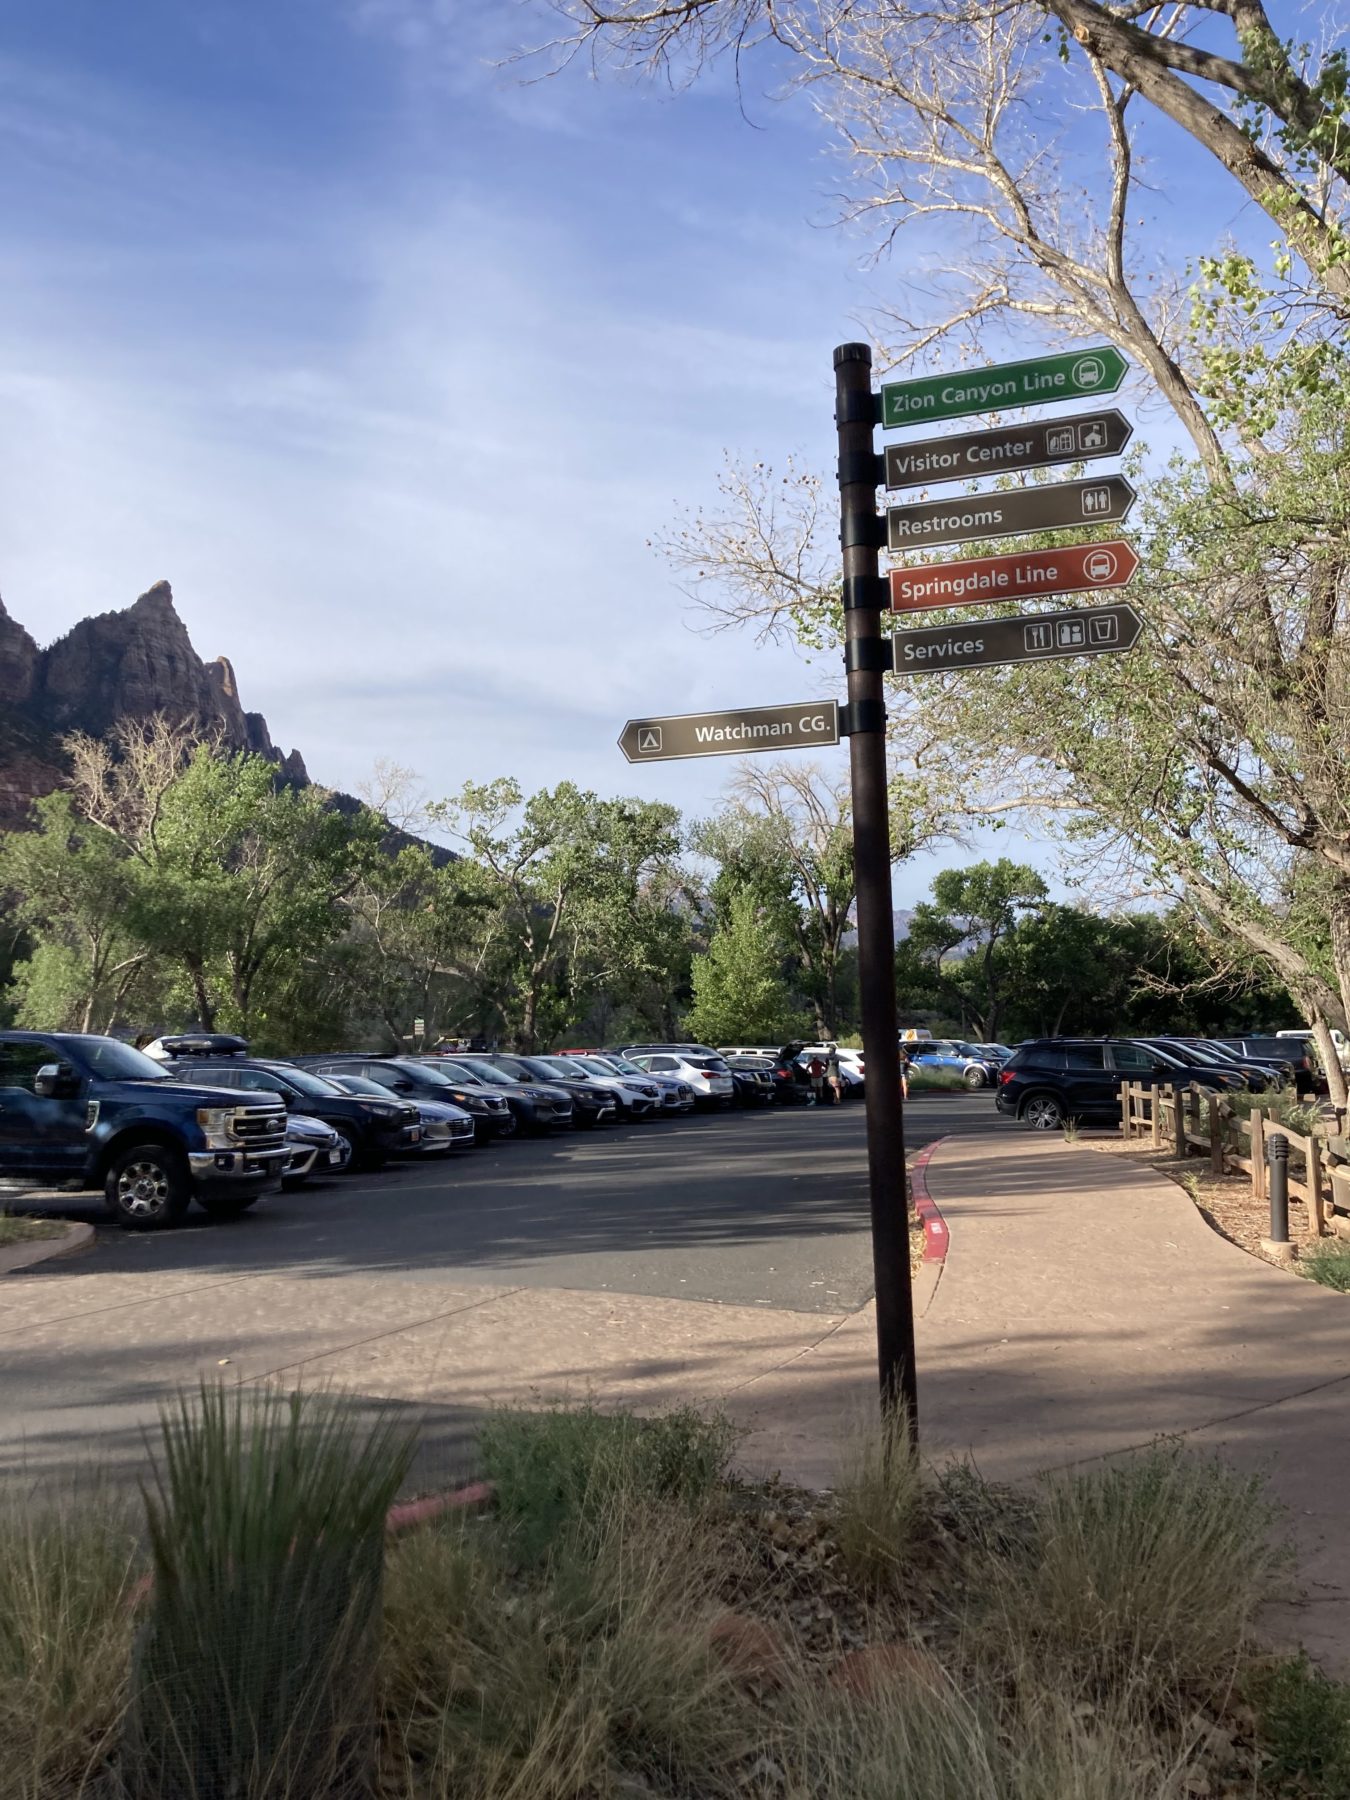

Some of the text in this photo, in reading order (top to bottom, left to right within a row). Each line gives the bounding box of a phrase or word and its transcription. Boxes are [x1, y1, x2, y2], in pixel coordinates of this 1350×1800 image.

[893, 372, 1065, 413] Zion Canyon Line
[896, 439, 1034, 474] Visitor Center
[898, 510, 1003, 536] Restrooms
[901, 565, 1058, 600] Springdale Line
[903, 639, 984, 660] Services
[695, 715, 831, 742] Watchman CG.
